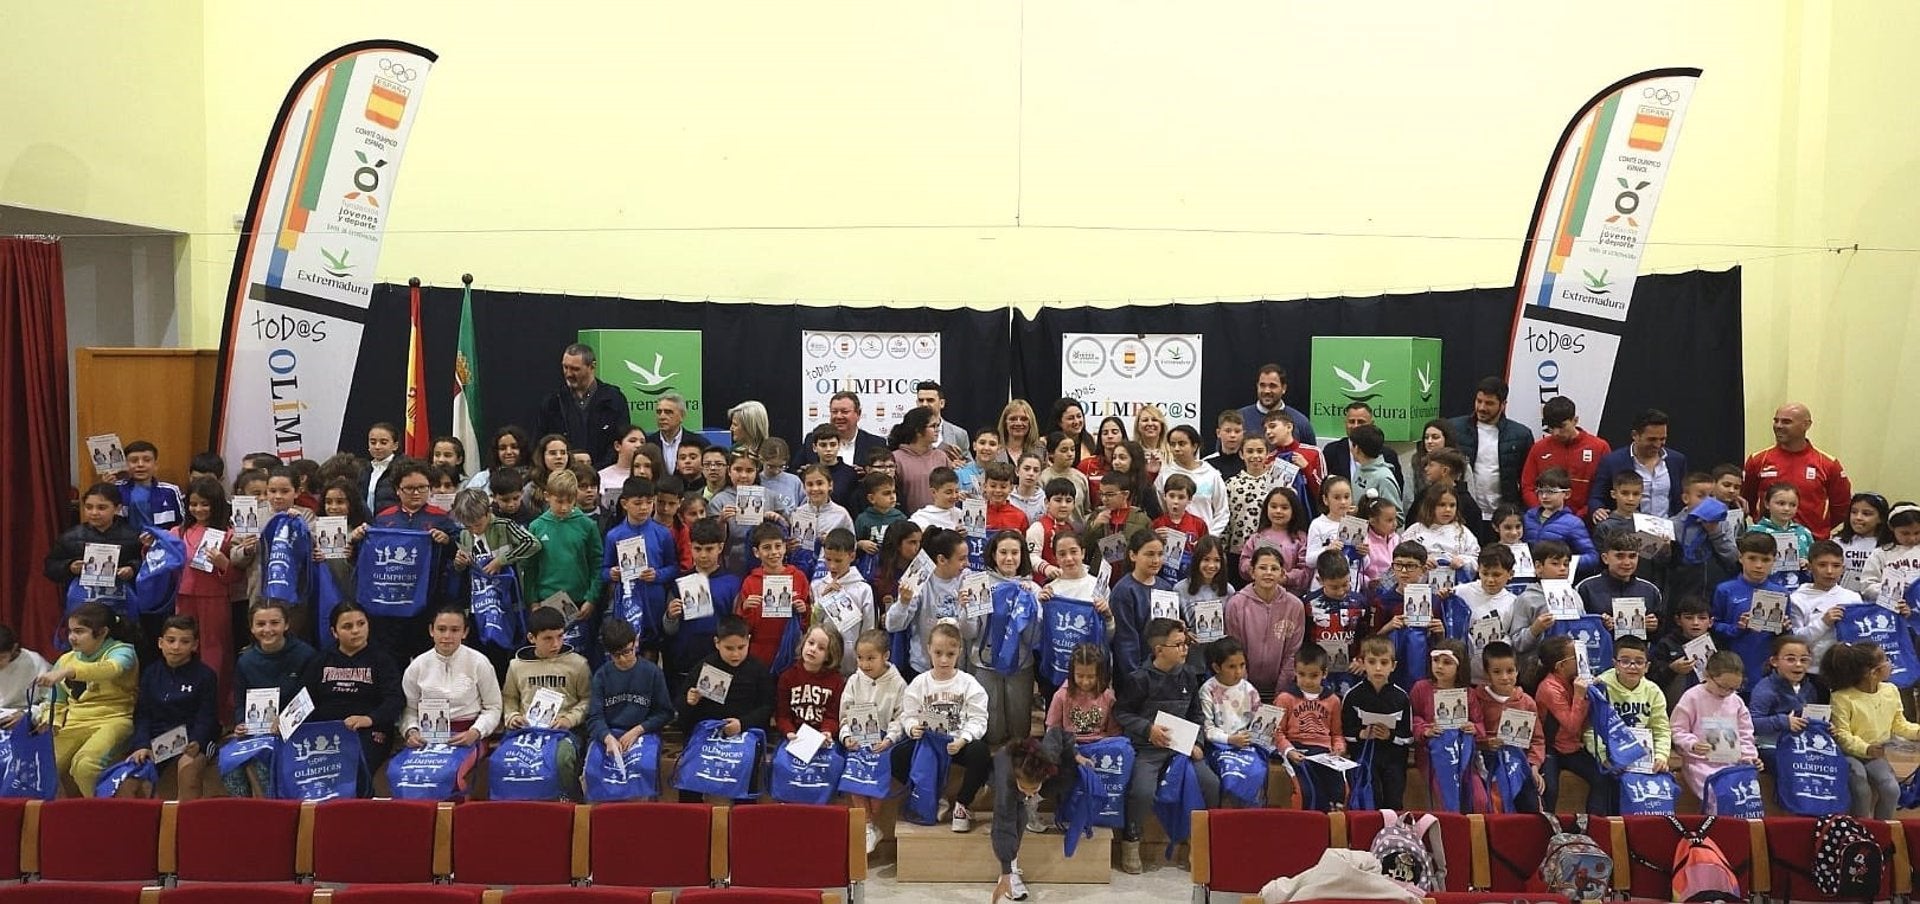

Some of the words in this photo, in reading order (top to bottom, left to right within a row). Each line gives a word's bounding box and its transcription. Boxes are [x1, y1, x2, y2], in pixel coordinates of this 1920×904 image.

[344, 217, 377, 231] deporte
[297, 269, 370, 297] Extremadura
[1562, 289, 1626, 311] Extremadura
[816, 374, 936, 395] OLÍMPIC@
[1313, 401, 1407, 419] Extrdura
[1845, 550, 1871, 559] CHIL
[790, 684, 833, 706] EAST
[1613, 701, 1651, 717] SONIC
